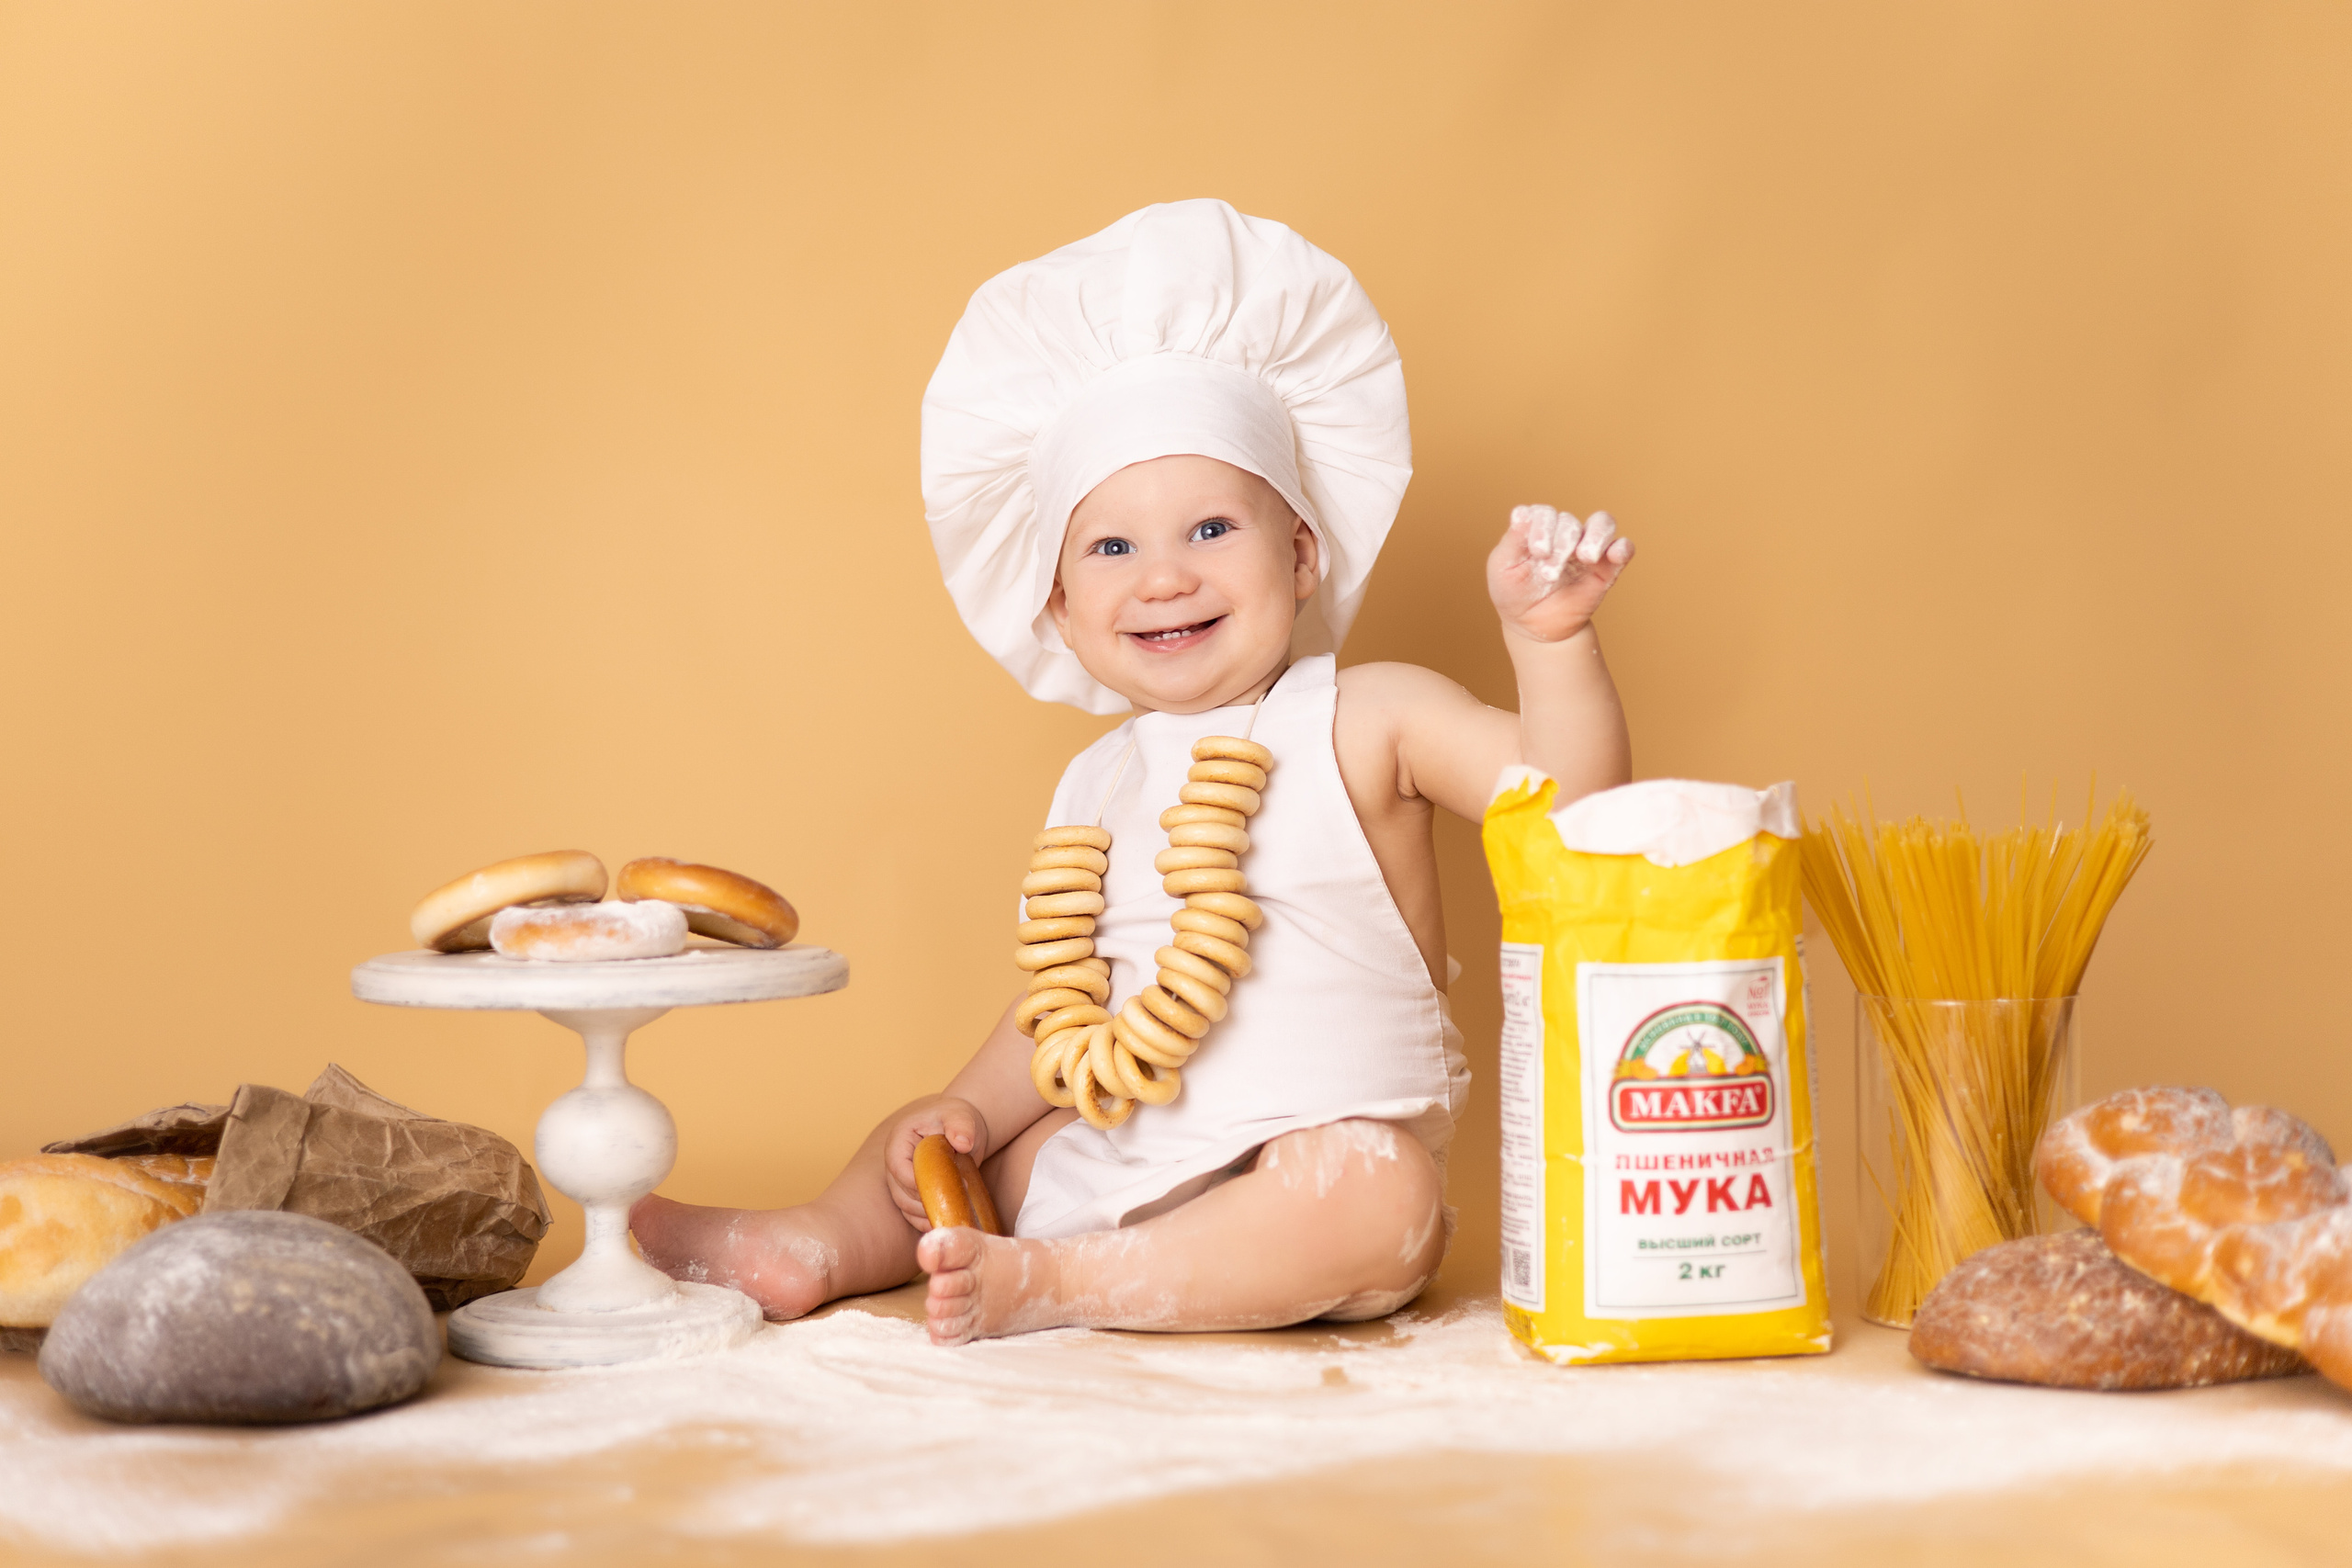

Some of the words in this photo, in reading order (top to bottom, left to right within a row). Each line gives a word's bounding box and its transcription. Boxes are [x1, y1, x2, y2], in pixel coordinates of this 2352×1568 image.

[1629, 1087, 1761, 1118] MAKFA
[1615, 1146, 1775, 1170] ПШЕНИЧНАЯ
[1620, 1172, 1773, 1215] МУКА
[1638, 1234, 1715, 1249] ВЫСШИЙ
[1722, 1233, 1762, 1247] СОРТ
[1679, 1262, 1693, 1280] 2
[1699, 1263, 1726, 1280] кг
